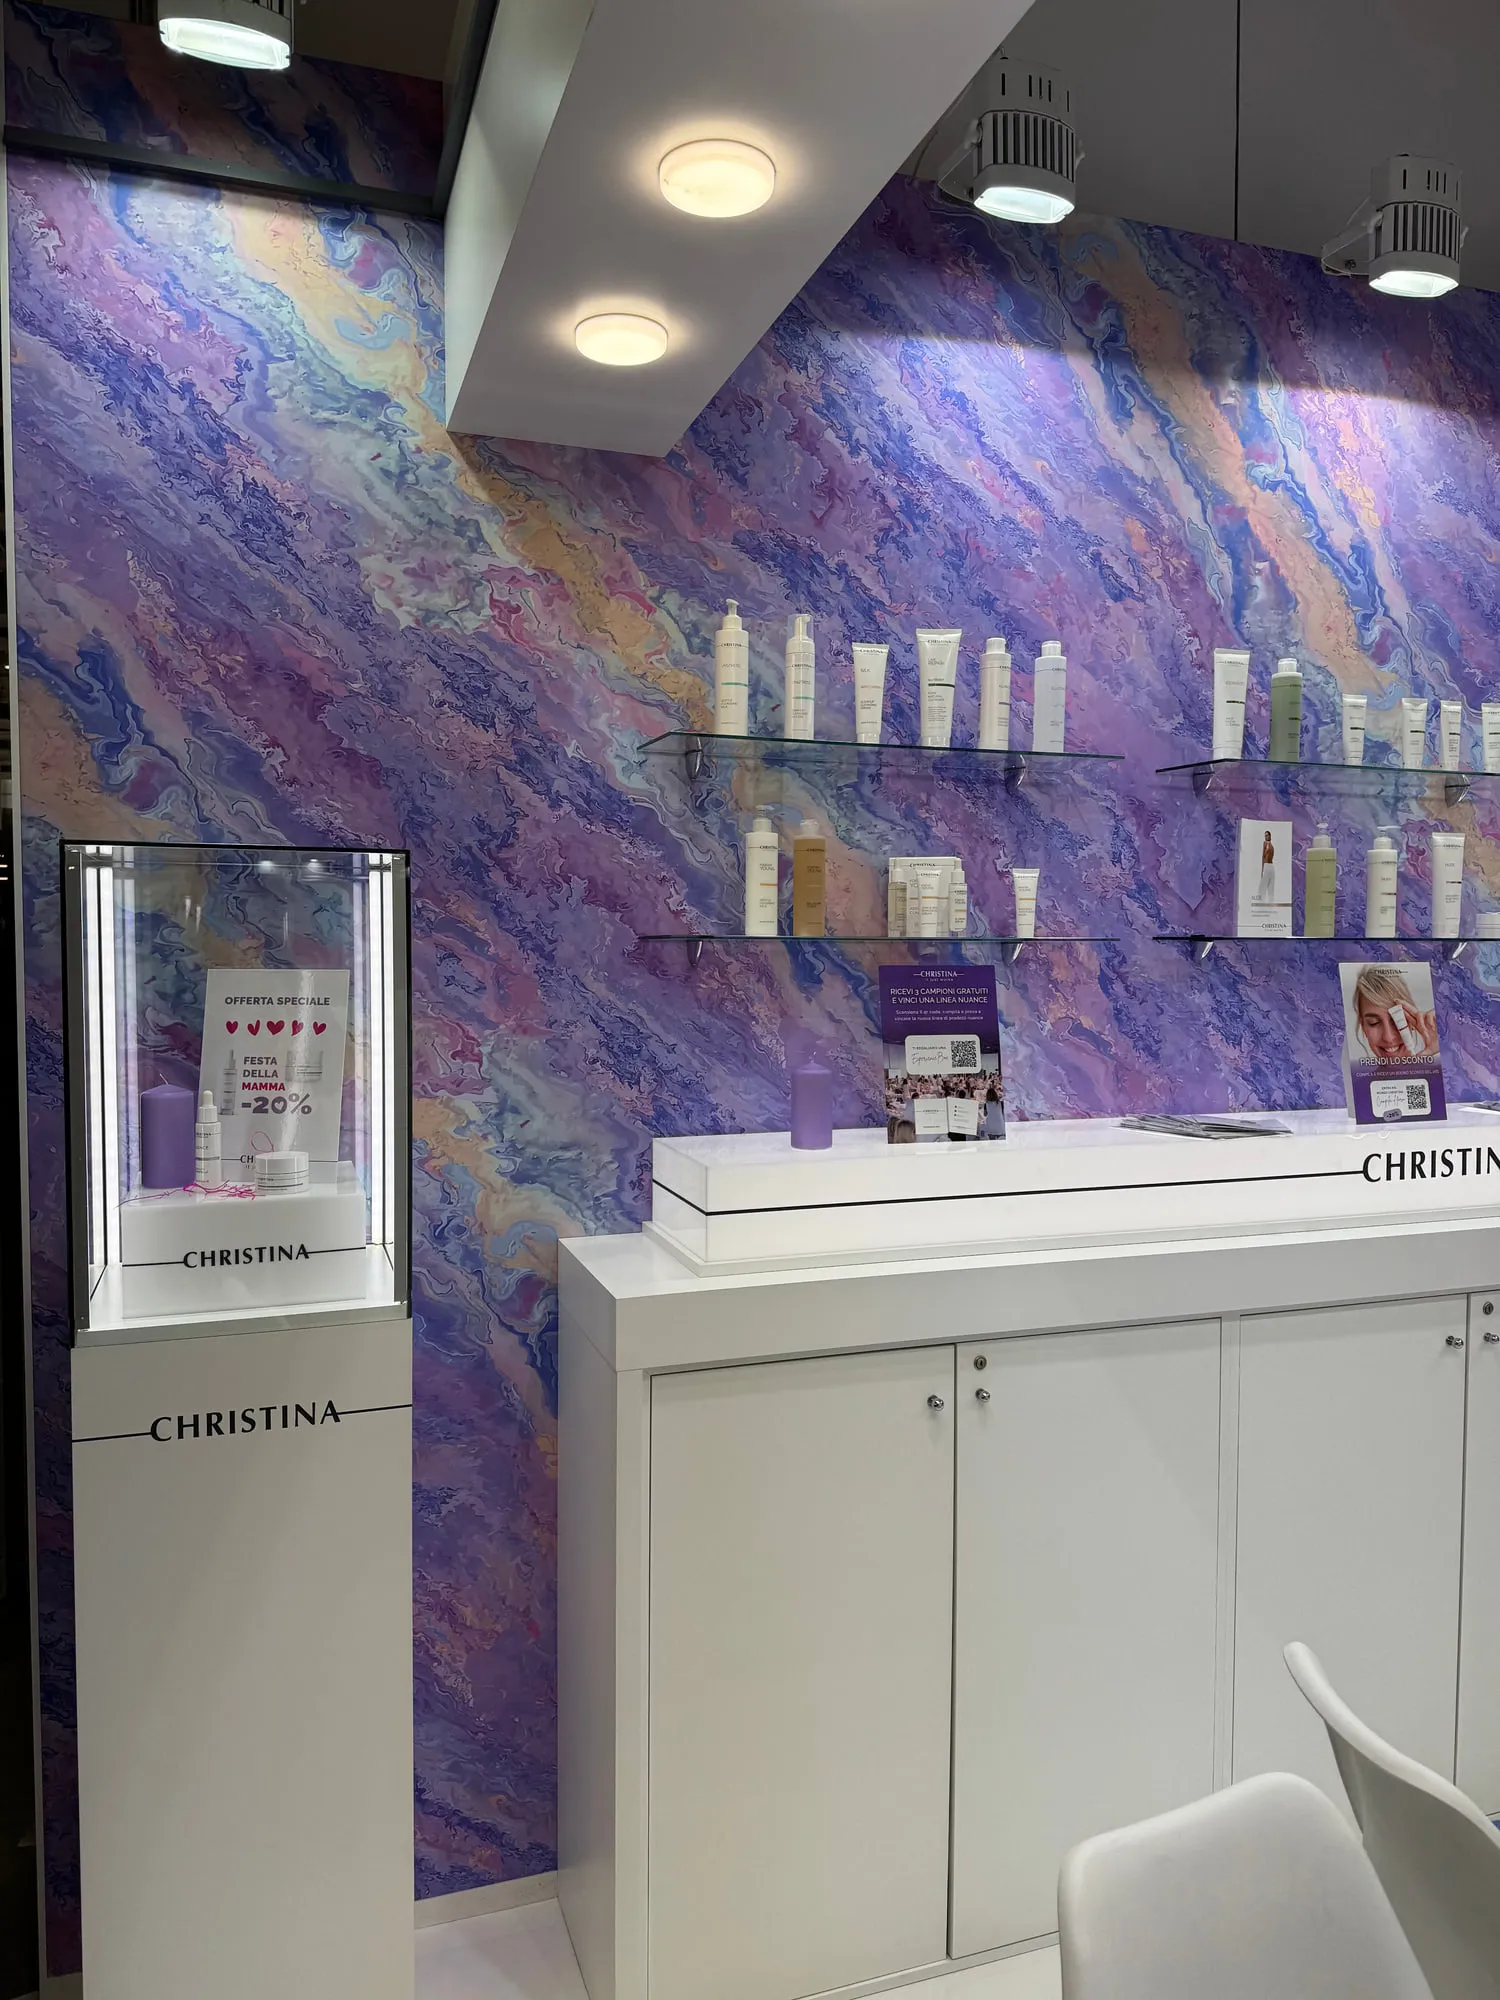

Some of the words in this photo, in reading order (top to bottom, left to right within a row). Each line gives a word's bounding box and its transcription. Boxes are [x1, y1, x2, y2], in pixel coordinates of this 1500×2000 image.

[920, 970, 957, 978] CHRISTINA
[890, 988, 914, 996] RICEVI
[956, 987, 989, 995] GRATUITI
[224, 996, 274, 1006] OFFERTA
[276, 996, 331, 1006] SPECIALE
[898, 996, 918, 1004] VINCI
[919, 996, 935, 1004] UNA
[243, 1056, 278, 1066] FESTA
[1360, 1057, 1389, 1066] PRENDI
[1389, 1057, 1400, 1065] LO
[1401, 1056, 1434, 1064] SCONTO
[243, 1069, 279, 1078] DELLA
[241, 1082, 286, 1092] MAMMA
[241, 1093, 313, 1115] -20%
[183, 1243, 310, 1269] CHRISTINA
[150, 1400, 342, 1442] CHRISTINA
